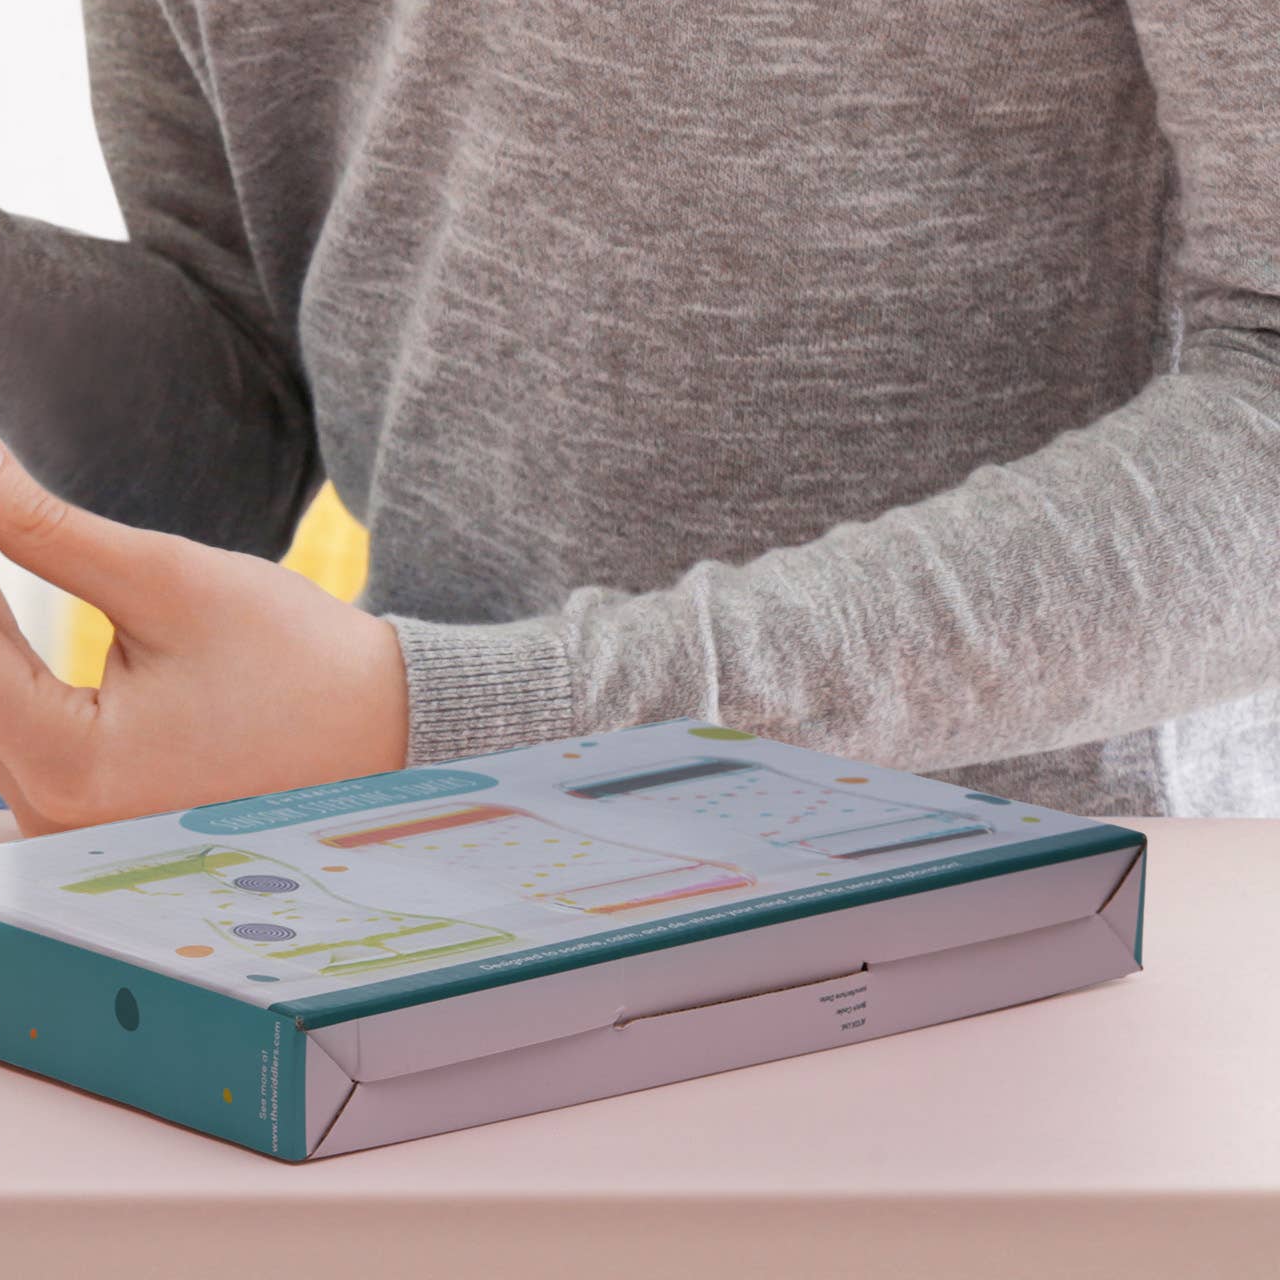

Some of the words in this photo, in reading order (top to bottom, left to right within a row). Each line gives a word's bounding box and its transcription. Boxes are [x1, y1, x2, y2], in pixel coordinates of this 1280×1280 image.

[479, 951, 541, 970] Designed
[641, 925, 667, 934] and
[261, 1049, 269, 1063] at
[260, 1064, 268, 1096] more
[270, 1021, 280, 1153] www.thetwiddlers.com
[259, 1098, 268, 1121] See
